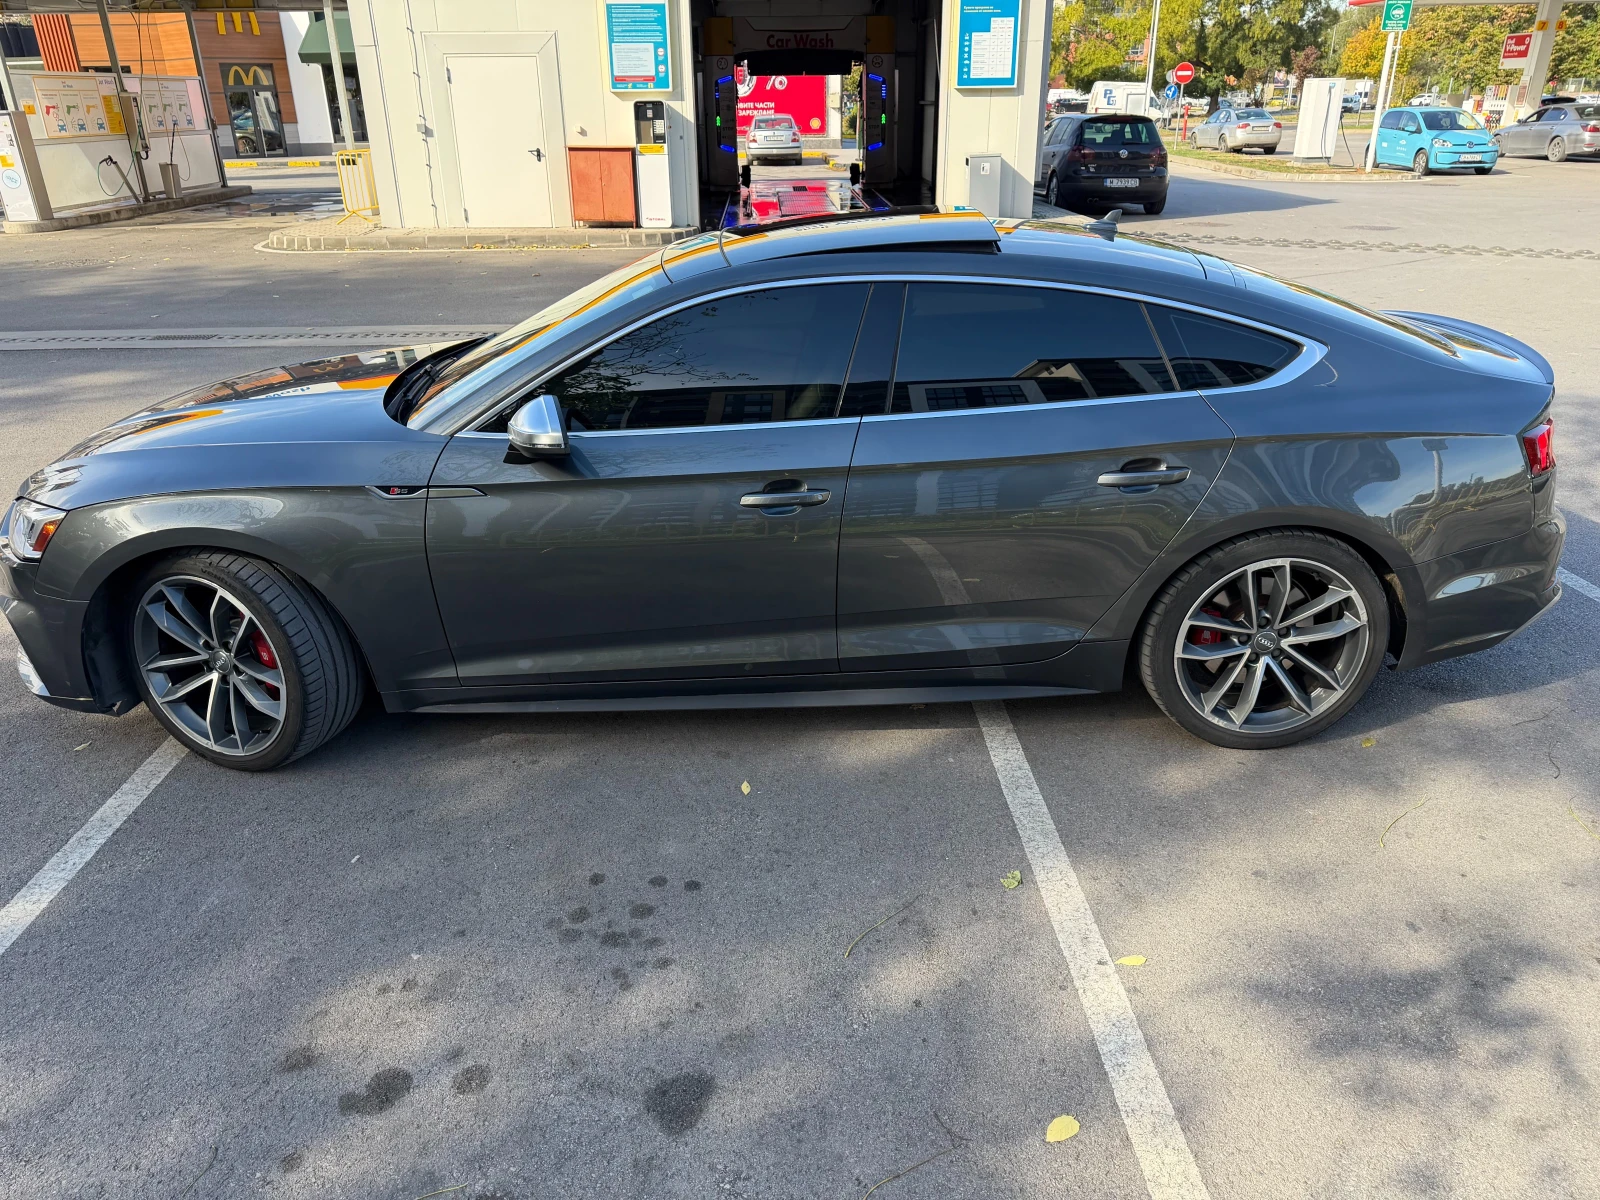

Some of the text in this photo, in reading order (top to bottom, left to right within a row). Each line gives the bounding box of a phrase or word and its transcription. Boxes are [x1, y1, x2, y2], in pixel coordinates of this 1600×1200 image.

[1541, 22, 1547, 30] 7
[1557, 21, 1564, 30] 8
[766, 32, 834, 48] Car Wash
